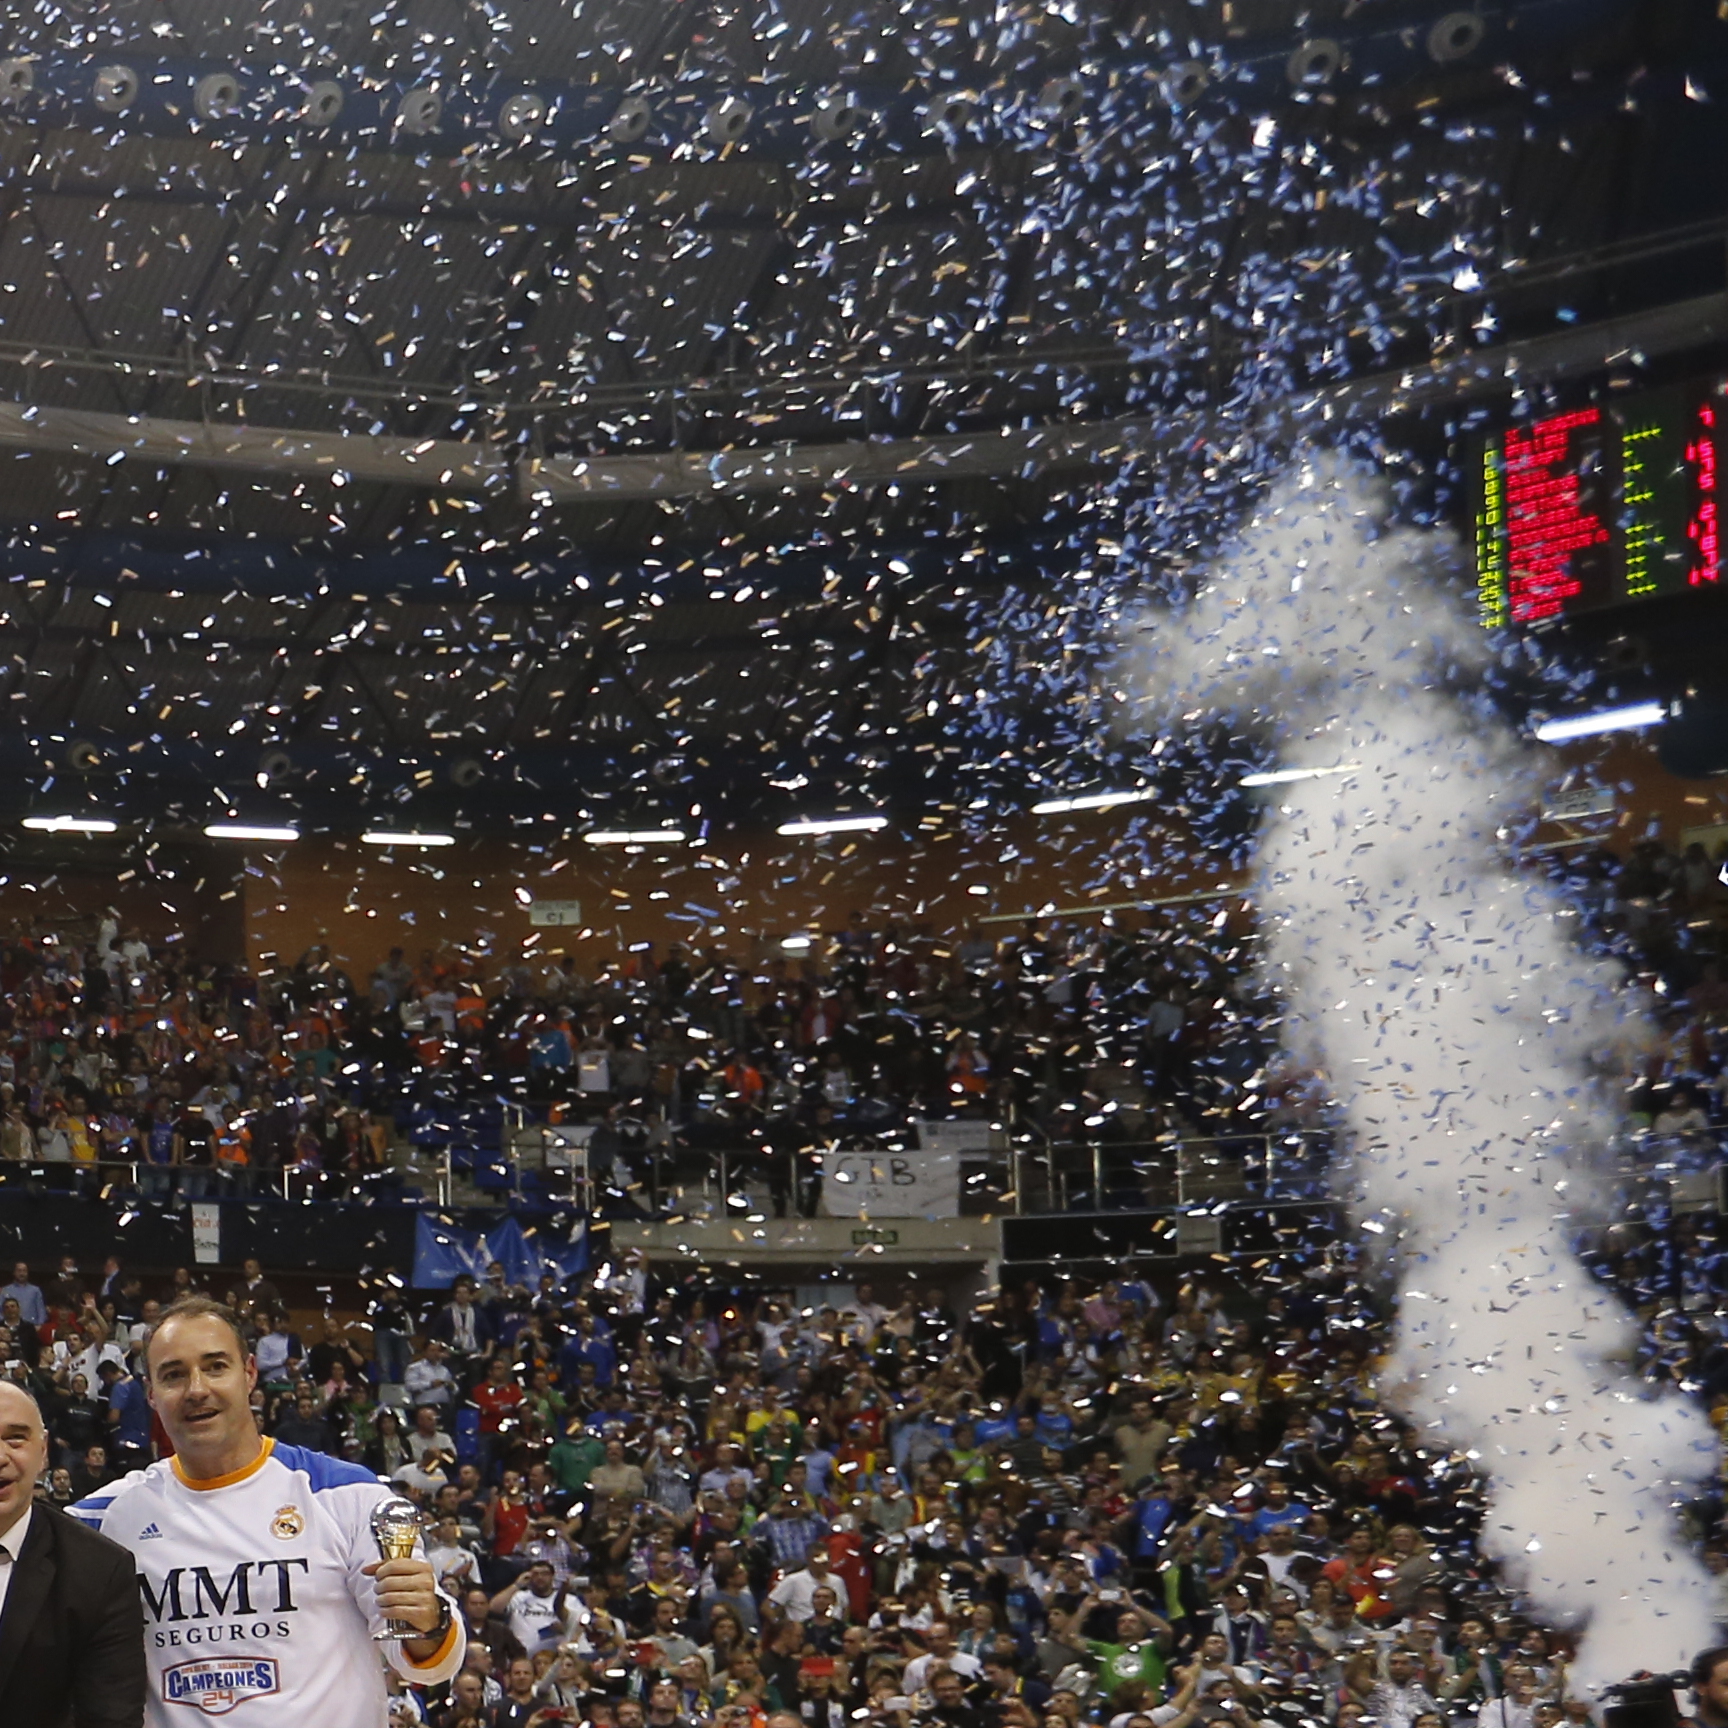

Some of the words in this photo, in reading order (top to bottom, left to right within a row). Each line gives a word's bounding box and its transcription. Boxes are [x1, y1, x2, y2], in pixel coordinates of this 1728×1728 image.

[136, 1558, 309, 1625] MMT
[155, 1621, 290, 1648] SEGUROS
[168, 1663, 272, 1698] CAMPEONES
[203, 1690, 234, 1707] 24
